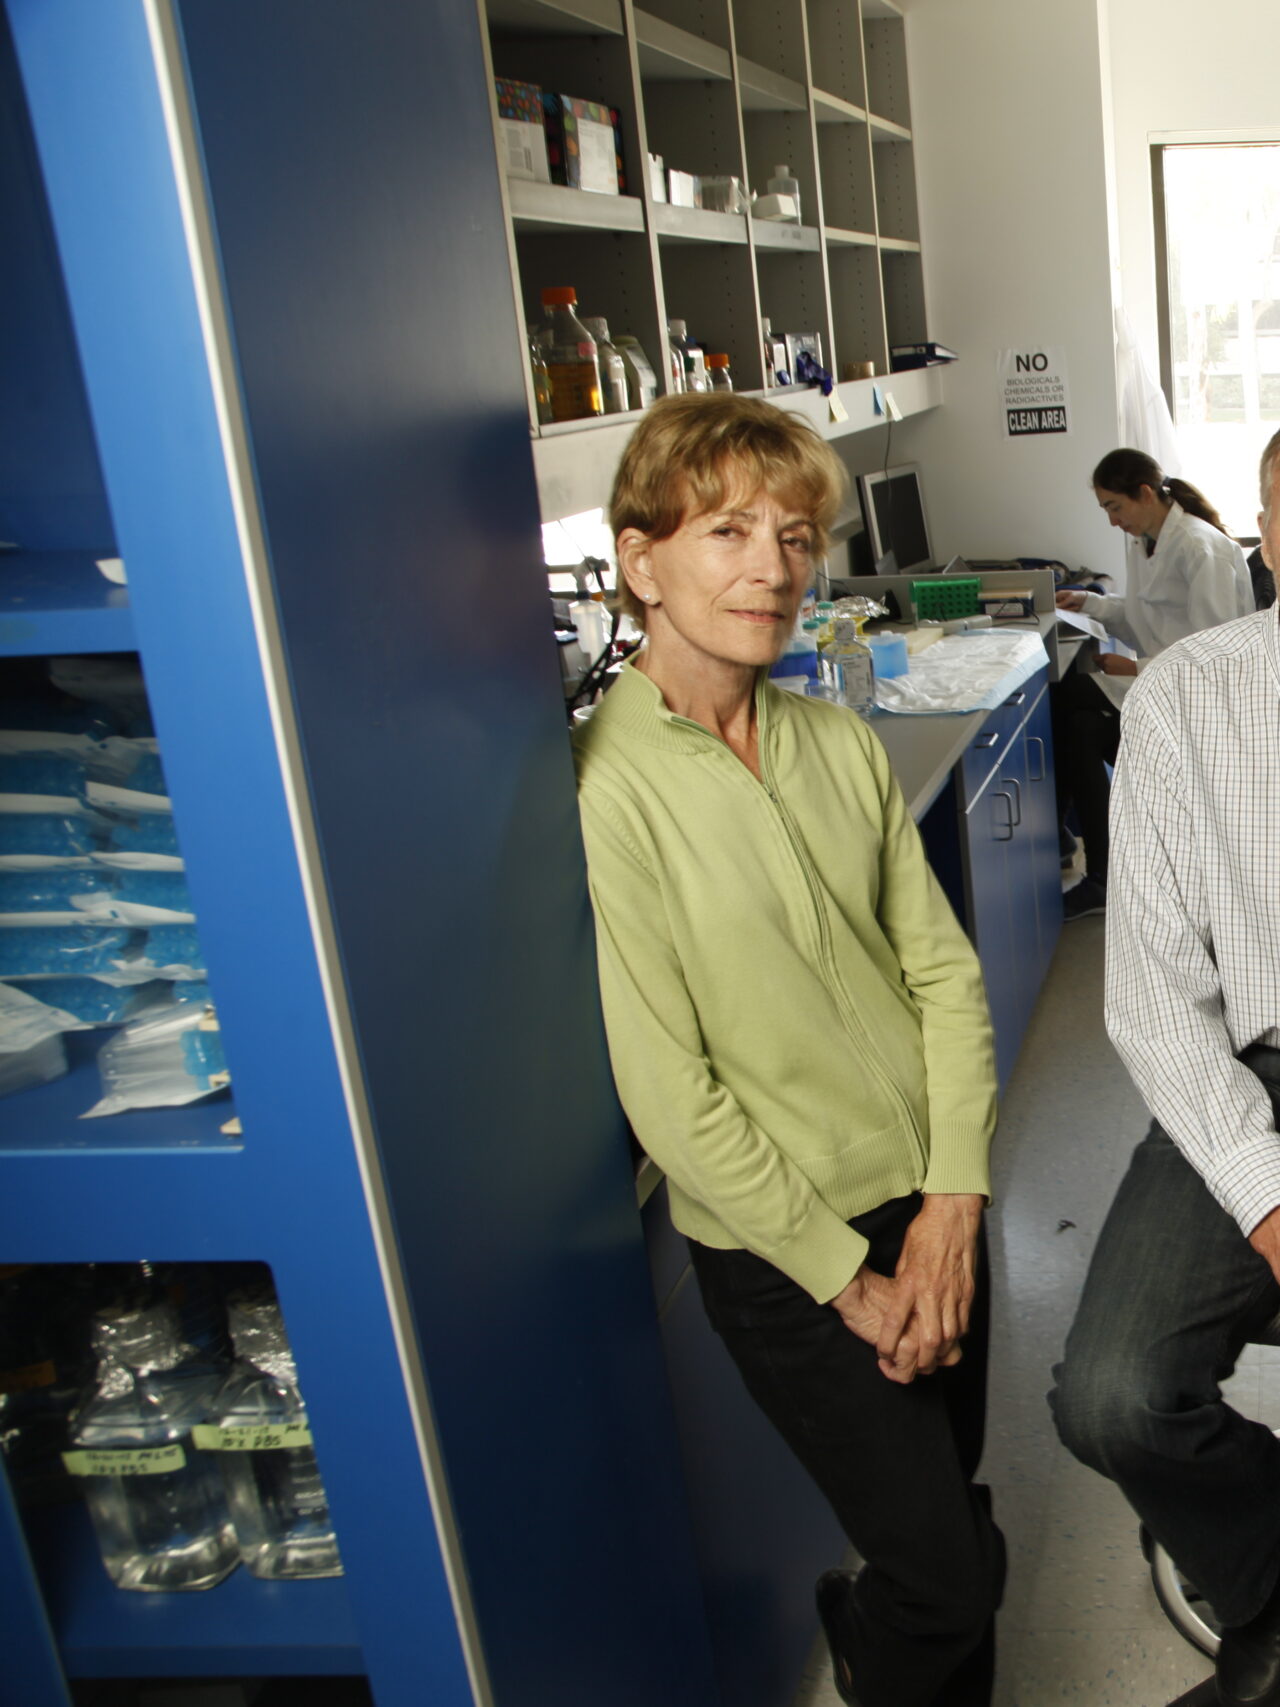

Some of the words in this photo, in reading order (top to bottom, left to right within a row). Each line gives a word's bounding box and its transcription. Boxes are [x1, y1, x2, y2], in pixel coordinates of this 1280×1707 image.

[1016, 353, 1048, 372] NO
[1006, 376, 1060, 386] BIOLOGICALS
[1004, 386, 1050, 396] CHEMICALS
[1052, 384, 1064, 392] OR
[1005, 394, 1064, 404] RADIOACTIVES
[1008, 410, 1039, 431] CLEAN
[1041, 409, 1066, 429] AREA
